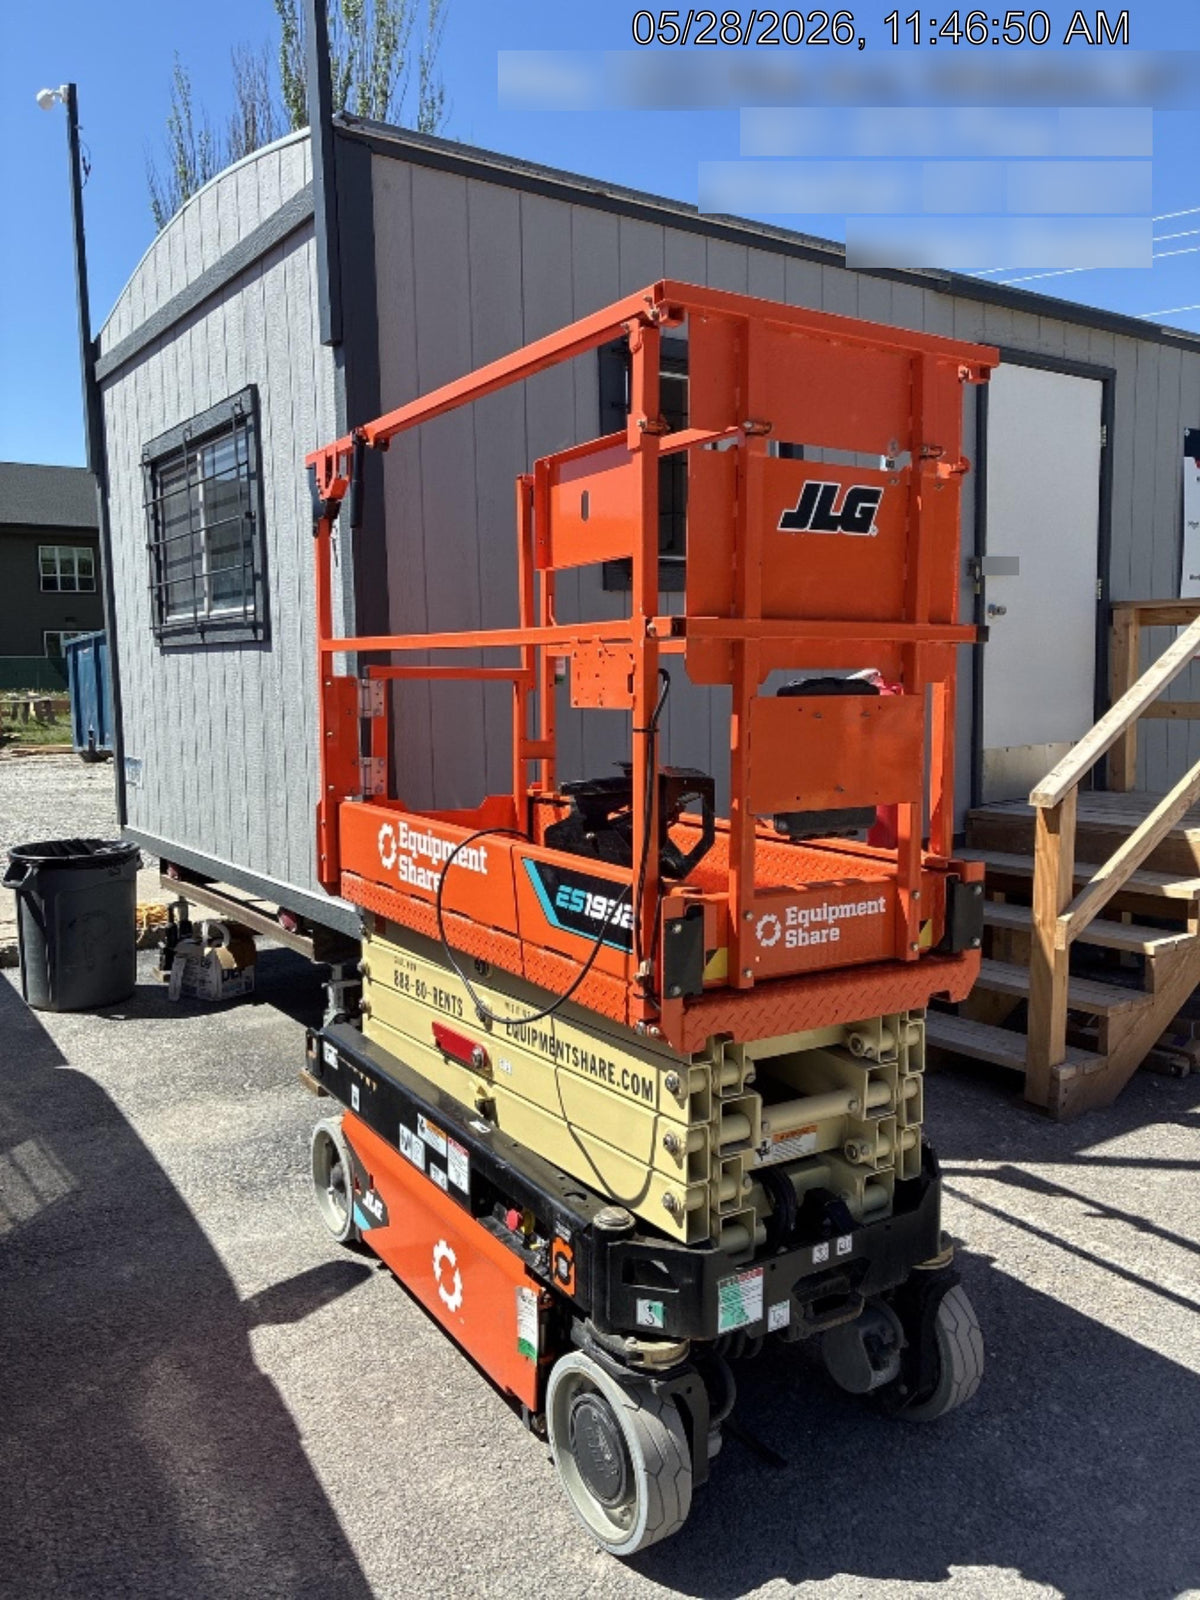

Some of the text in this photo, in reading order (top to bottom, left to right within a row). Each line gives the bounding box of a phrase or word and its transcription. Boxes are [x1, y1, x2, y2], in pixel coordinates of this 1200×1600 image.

[777, 480, 884, 536] JLG
[398, 821, 488, 875] Equipment
[785, 896, 886, 927] Equipment
[785, 926, 840, 948] Share
[505, 1016, 654, 1103] EQUIPMENTSHARE.COM
